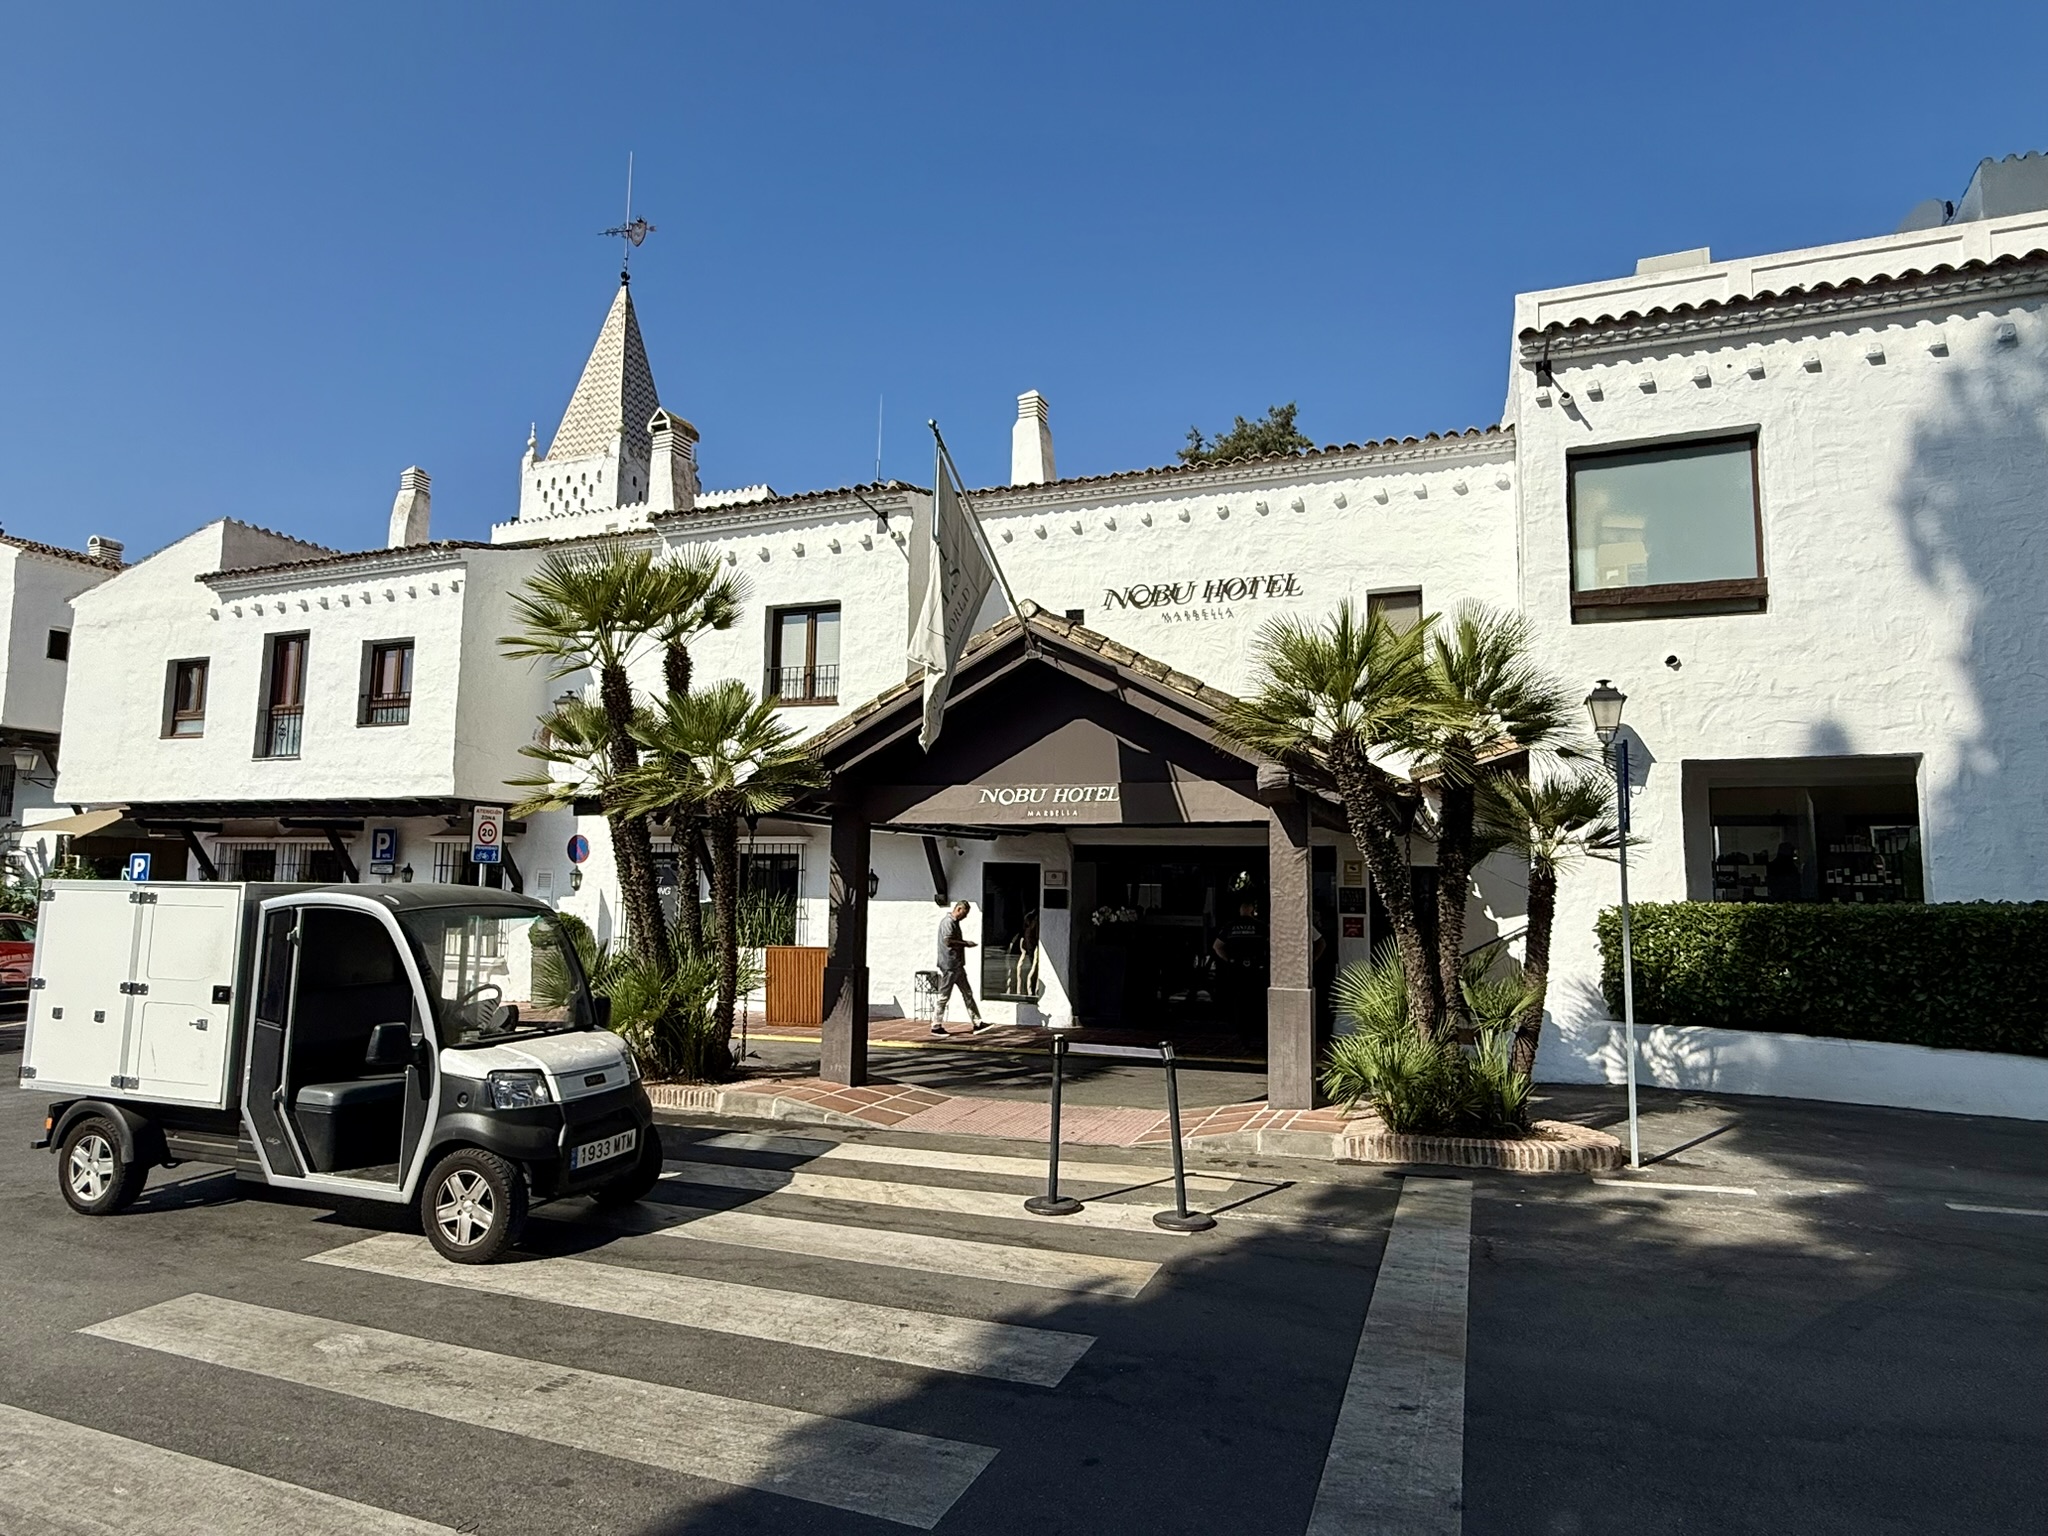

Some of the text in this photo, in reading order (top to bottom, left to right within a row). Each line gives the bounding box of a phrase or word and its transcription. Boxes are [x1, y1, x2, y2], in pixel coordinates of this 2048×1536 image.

[1101, 573, 1304, 610] NOBU HOTEL
[1161, 607, 1234, 624] MARBELLA
[978, 786, 1120, 806] NOBU HOTEL
[481, 828, 494, 837] 20
[375, 832, 391, 859] P
[132, 858, 146, 879] P
[581, 1132, 634, 1164] 1933 MTM
